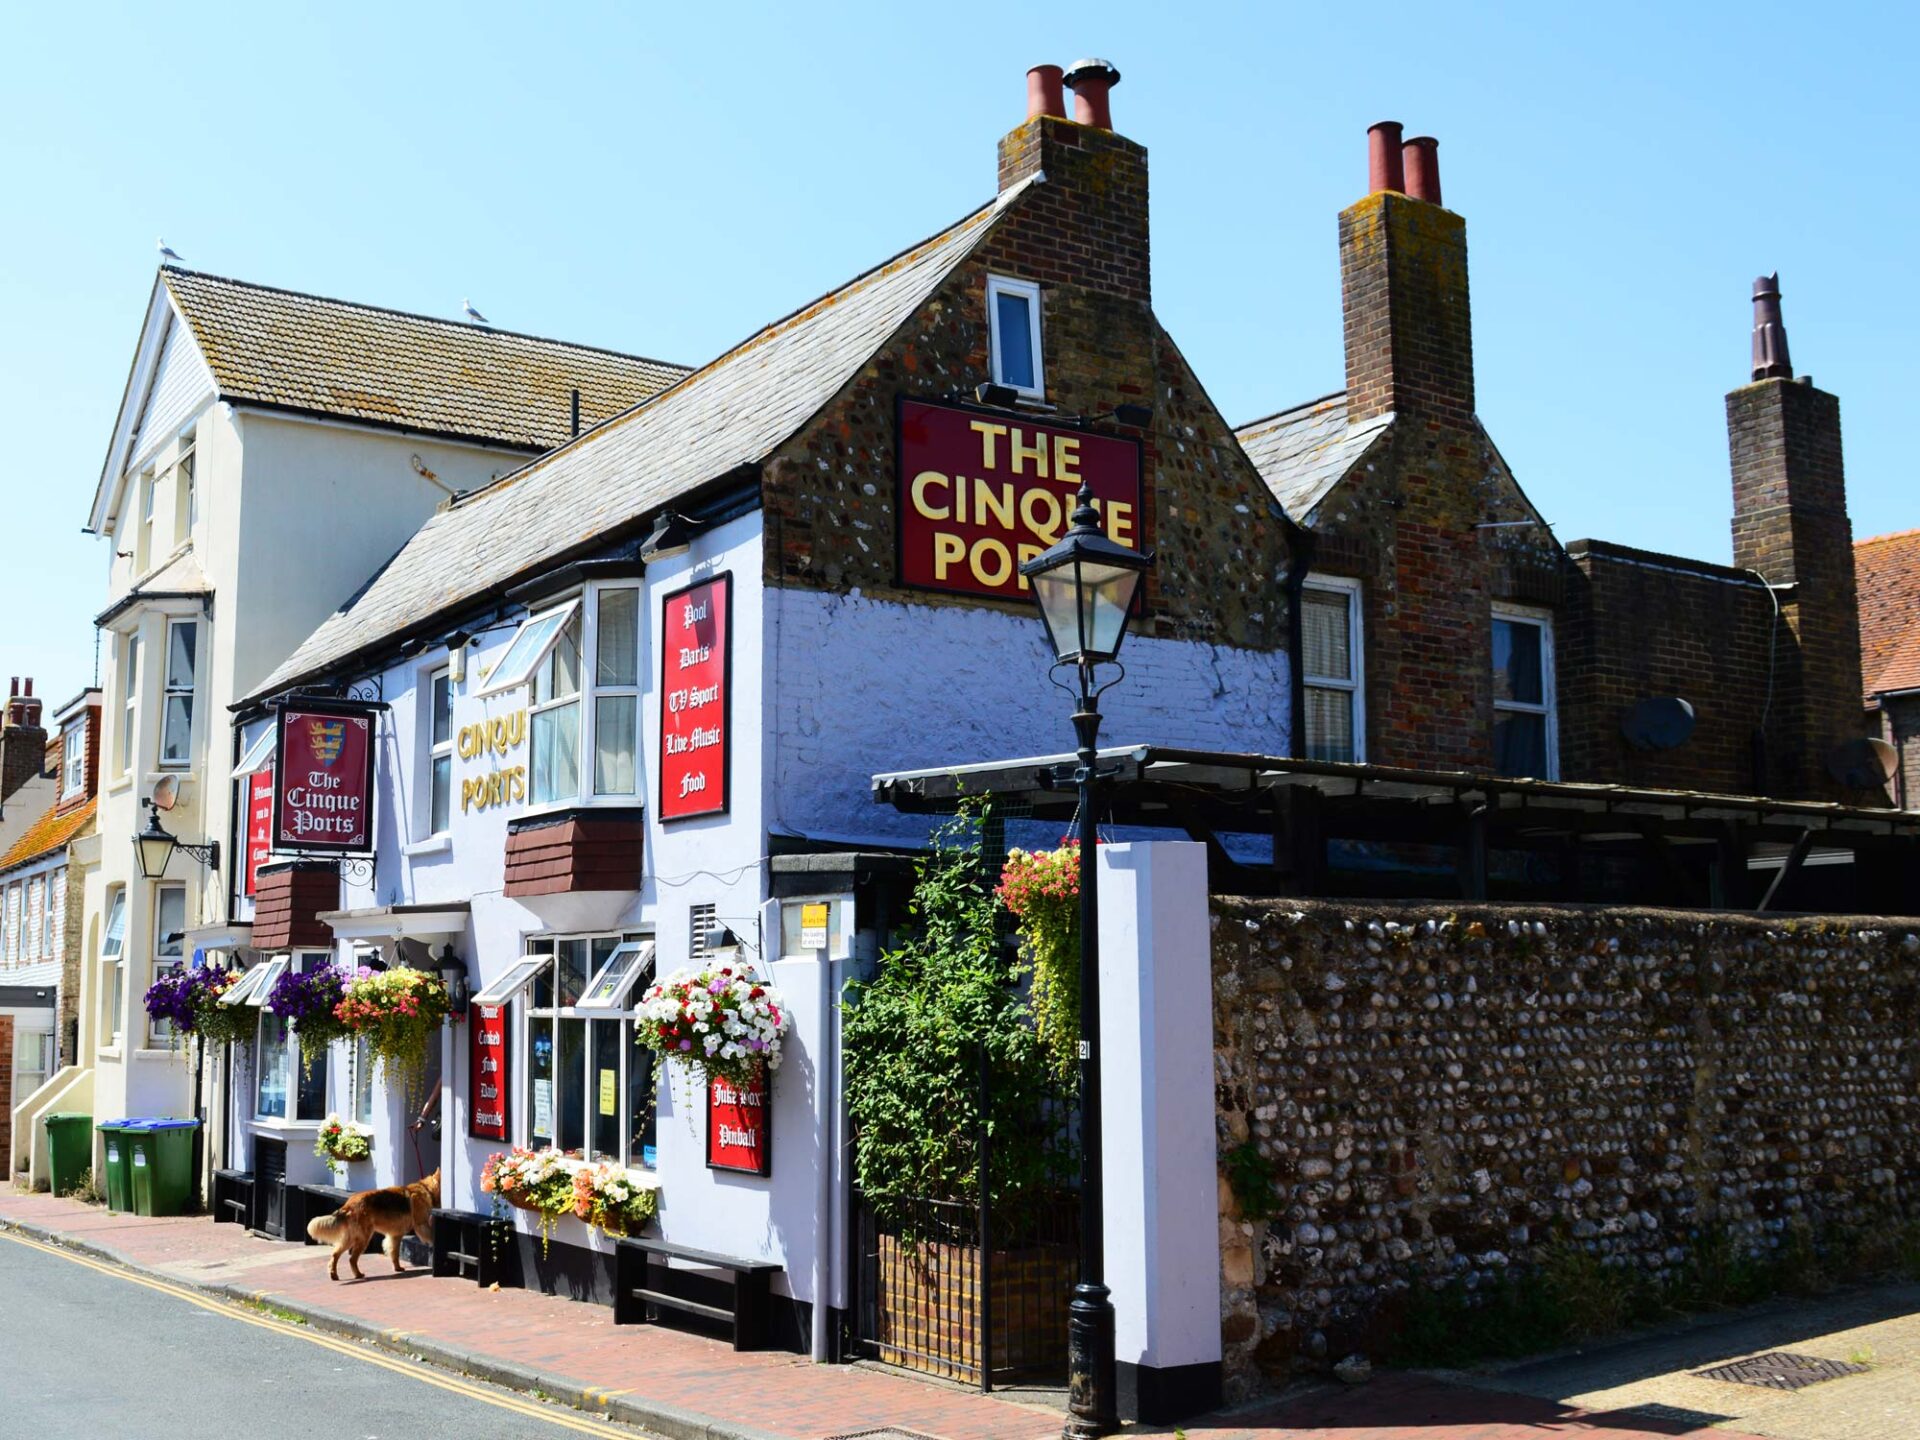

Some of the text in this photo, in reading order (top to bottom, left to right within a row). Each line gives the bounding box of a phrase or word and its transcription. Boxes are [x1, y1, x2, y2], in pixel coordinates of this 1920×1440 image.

[970, 420, 1082, 484] THE
[934, 532, 1048, 591] POR
[683, 600, 707, 629] Pool
[680, 643, 710, 669] Darts
[669, 682, 719, 713] TV Sport
[458, 709, 526, 759] CINQU
[666, 724, 720, 755] Live Music
[308, 770, 340, 791] The
[462, 764, 526, 812] PORTS
[679, 772, 706, 798] Food
[287, 787, 360, 813] Cinque
[292, 810, 355, 835] Ports
[478, 1030, 500, 1046] Cooked
[481, 1056, 498, 1074] Food
[480, 1082, 498, 1100] Daily
[713, 1083, 737, 1107] Juke
[476, 1108, 502, 1127] Specials
[718, 1123, 756, 1148] Pinball
